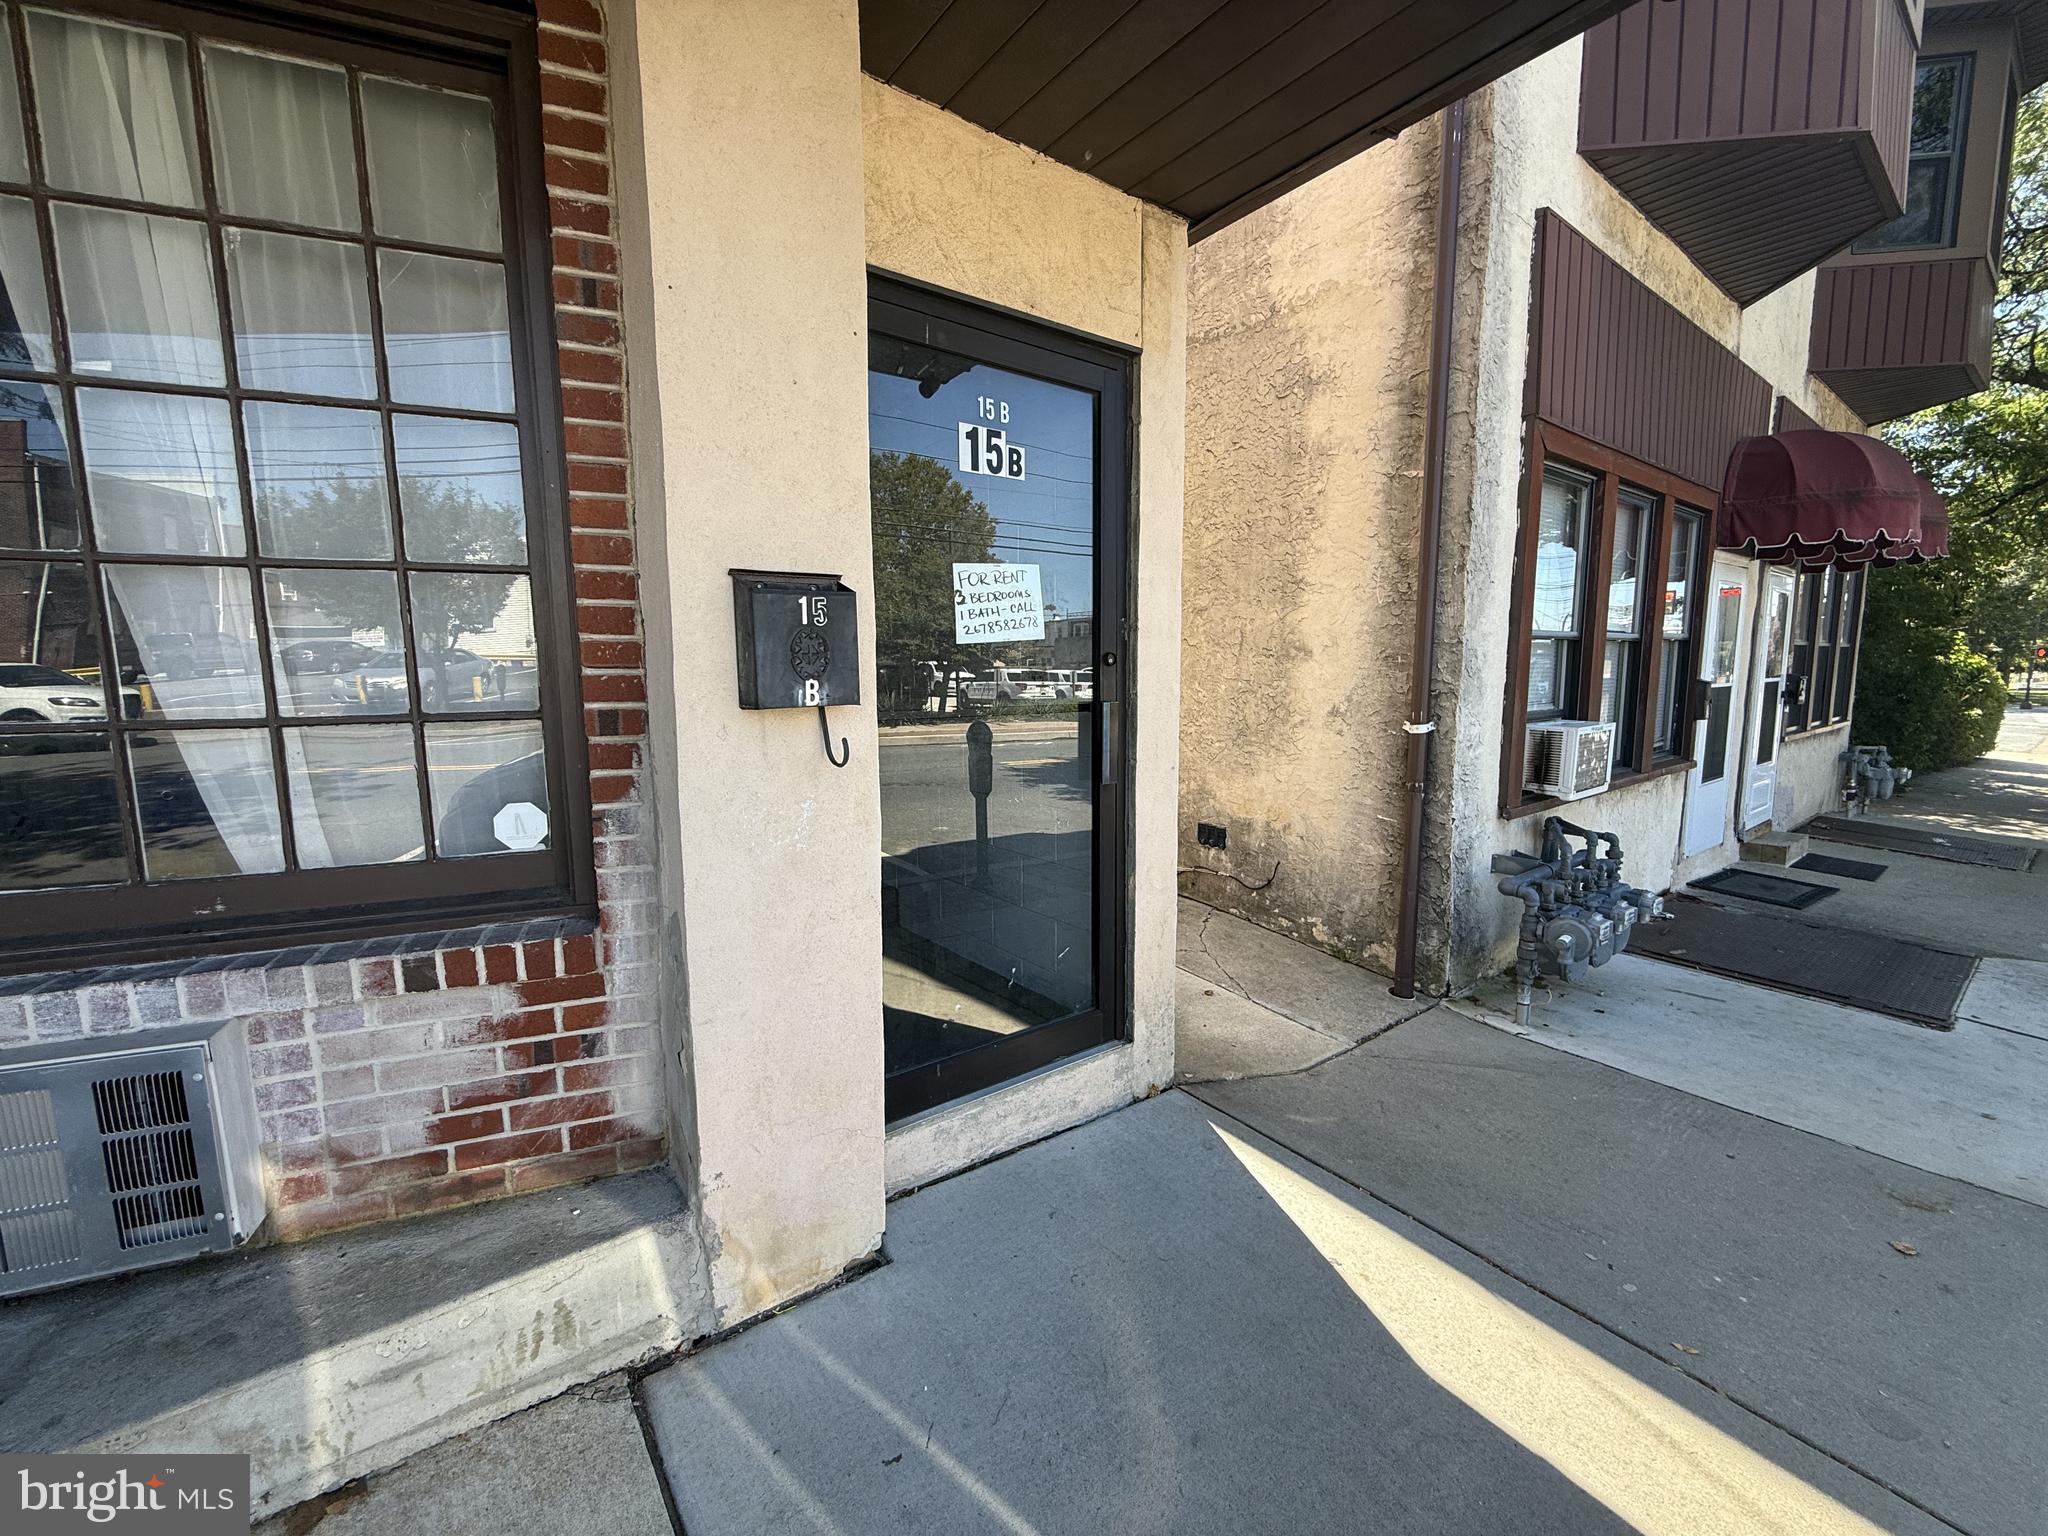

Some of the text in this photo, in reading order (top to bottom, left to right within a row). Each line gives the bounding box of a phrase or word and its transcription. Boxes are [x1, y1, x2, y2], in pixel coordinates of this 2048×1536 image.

[978, 396, 1010, 424] 15 B
[957, 569, 1027, 589] FOR RENT
[798, 596, 828, 626] 15
[960, 611, 964, 620] 1
[963, 616, 1038, 635] 2678582678
[805, 678, 820, 706] B
